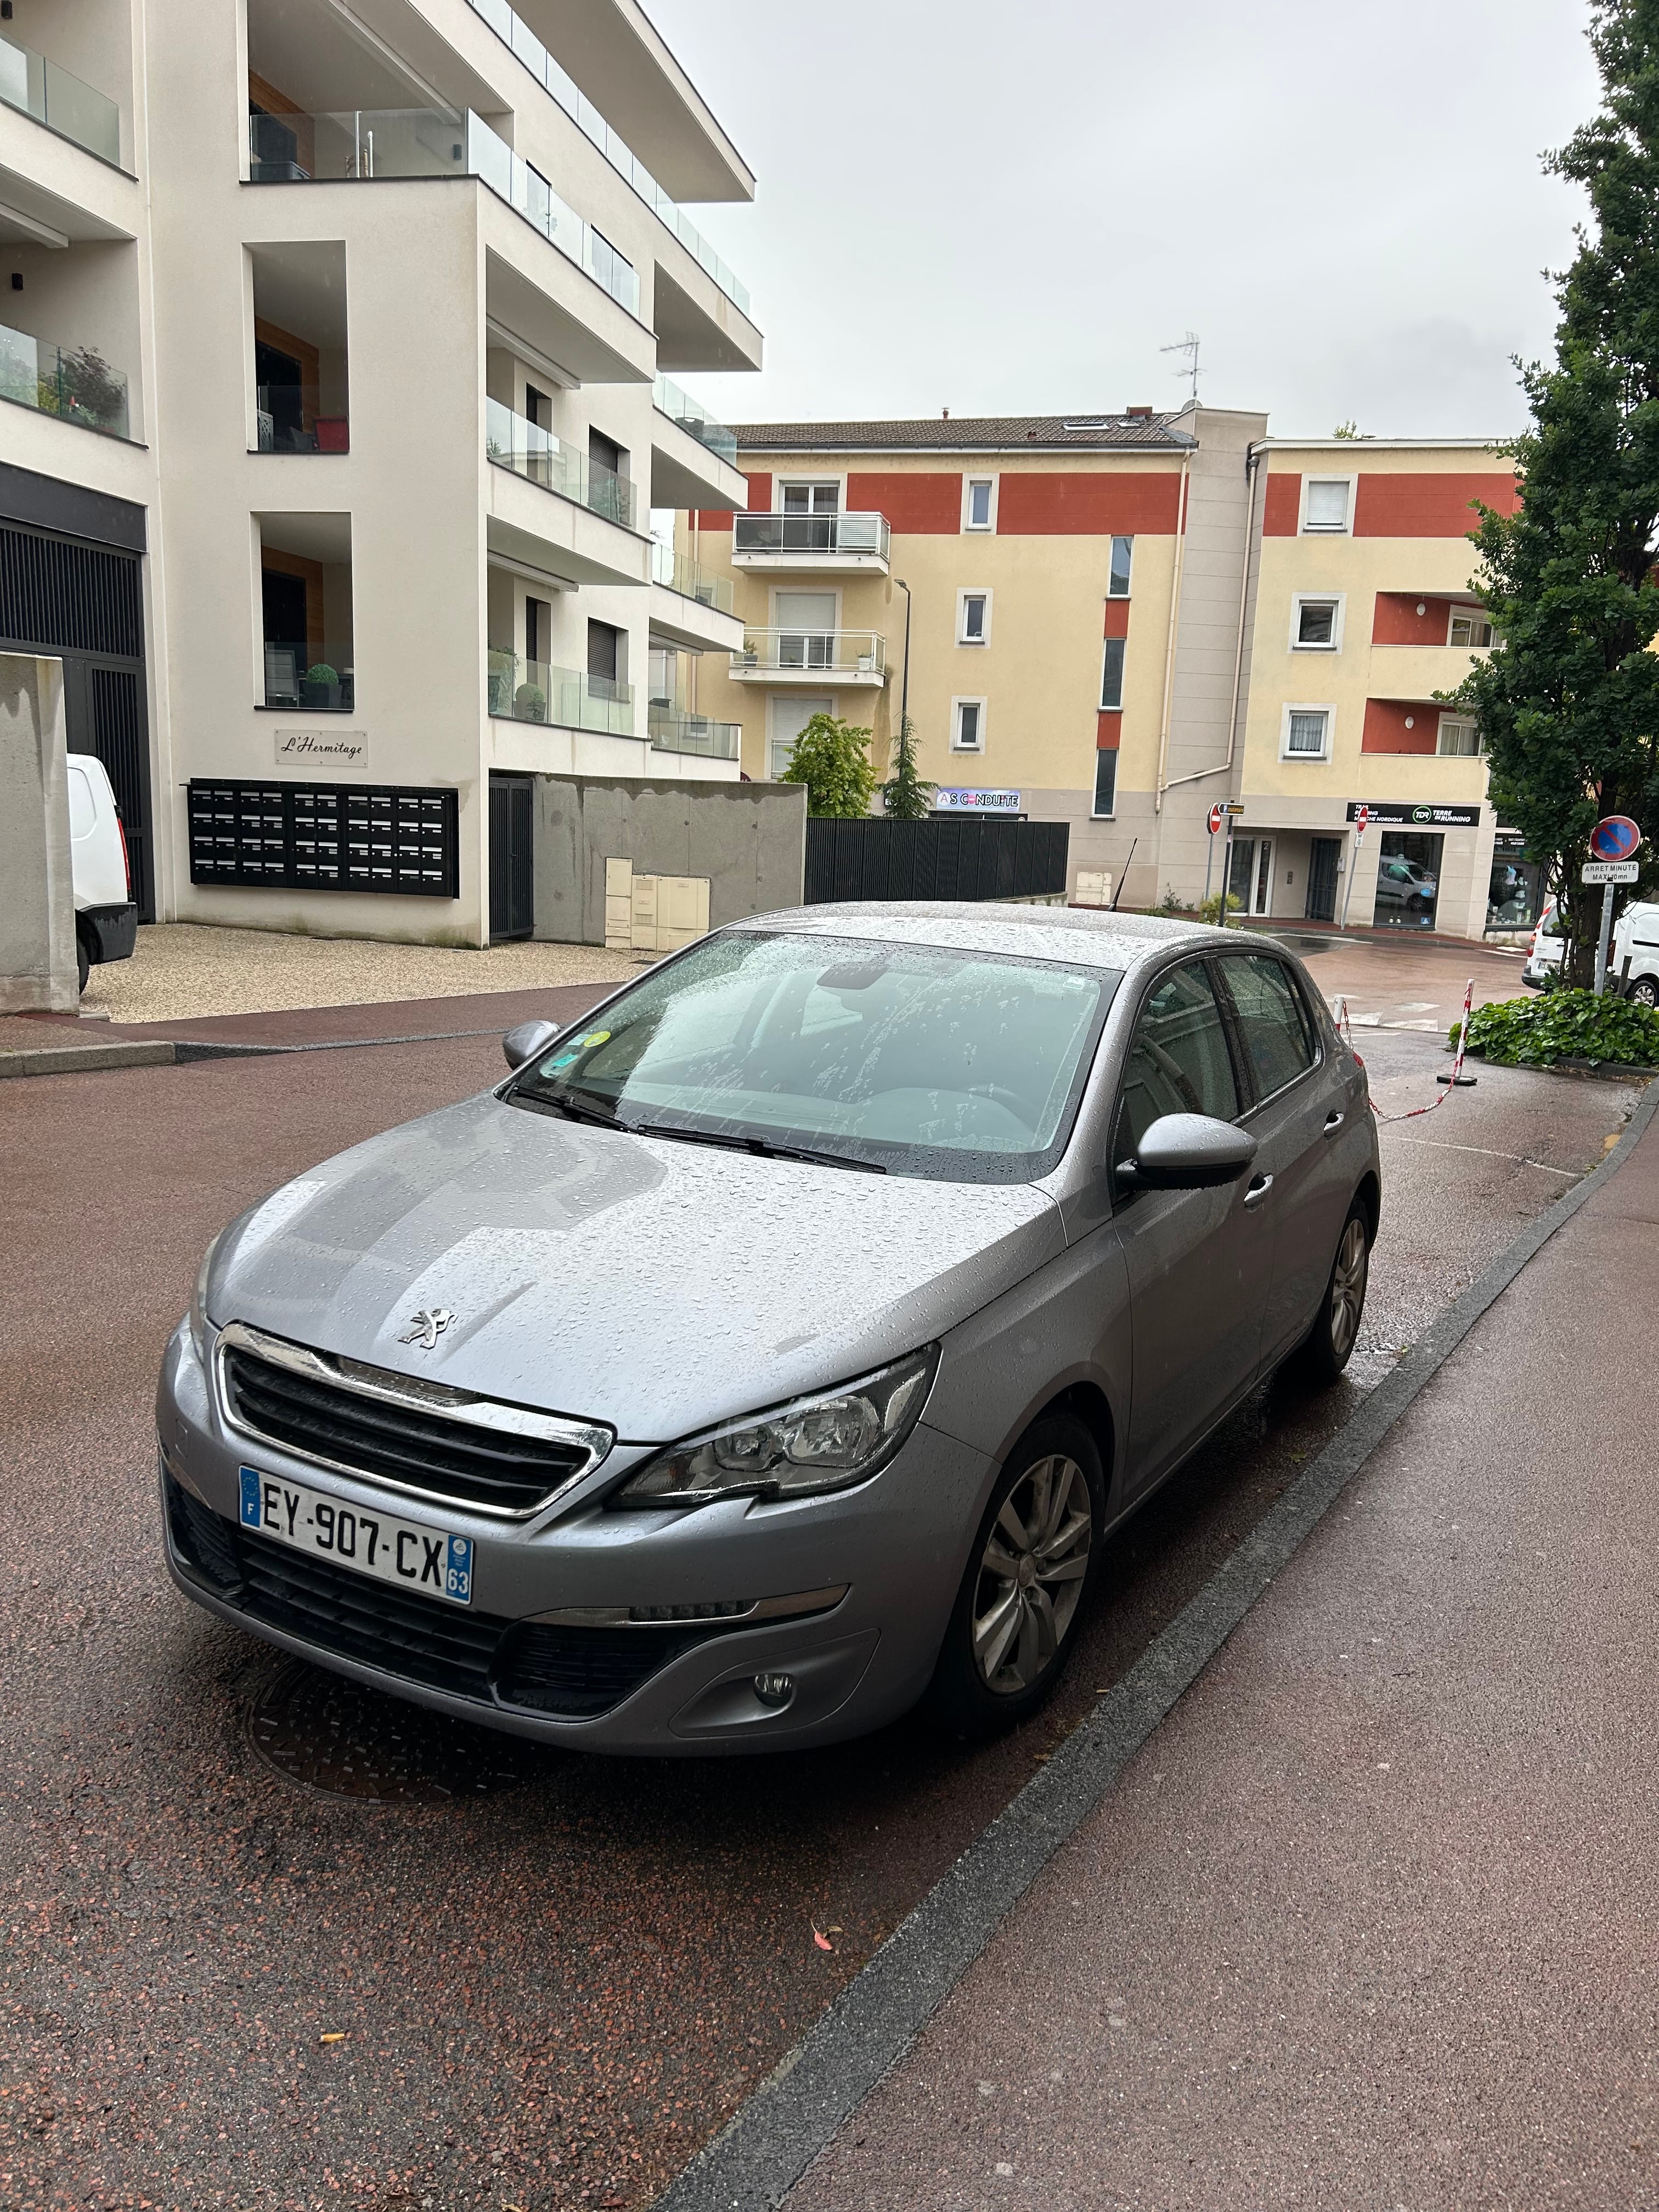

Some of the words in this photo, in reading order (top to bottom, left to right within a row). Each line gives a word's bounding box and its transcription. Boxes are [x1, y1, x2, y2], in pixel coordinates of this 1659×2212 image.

[281, 736, 362, 759] L'Hermitage
[247, 1503, 254, 1515] F
[263, 1482, 443, 1587] EY-907-CX
[448, 1568, 469, 1594] 63
